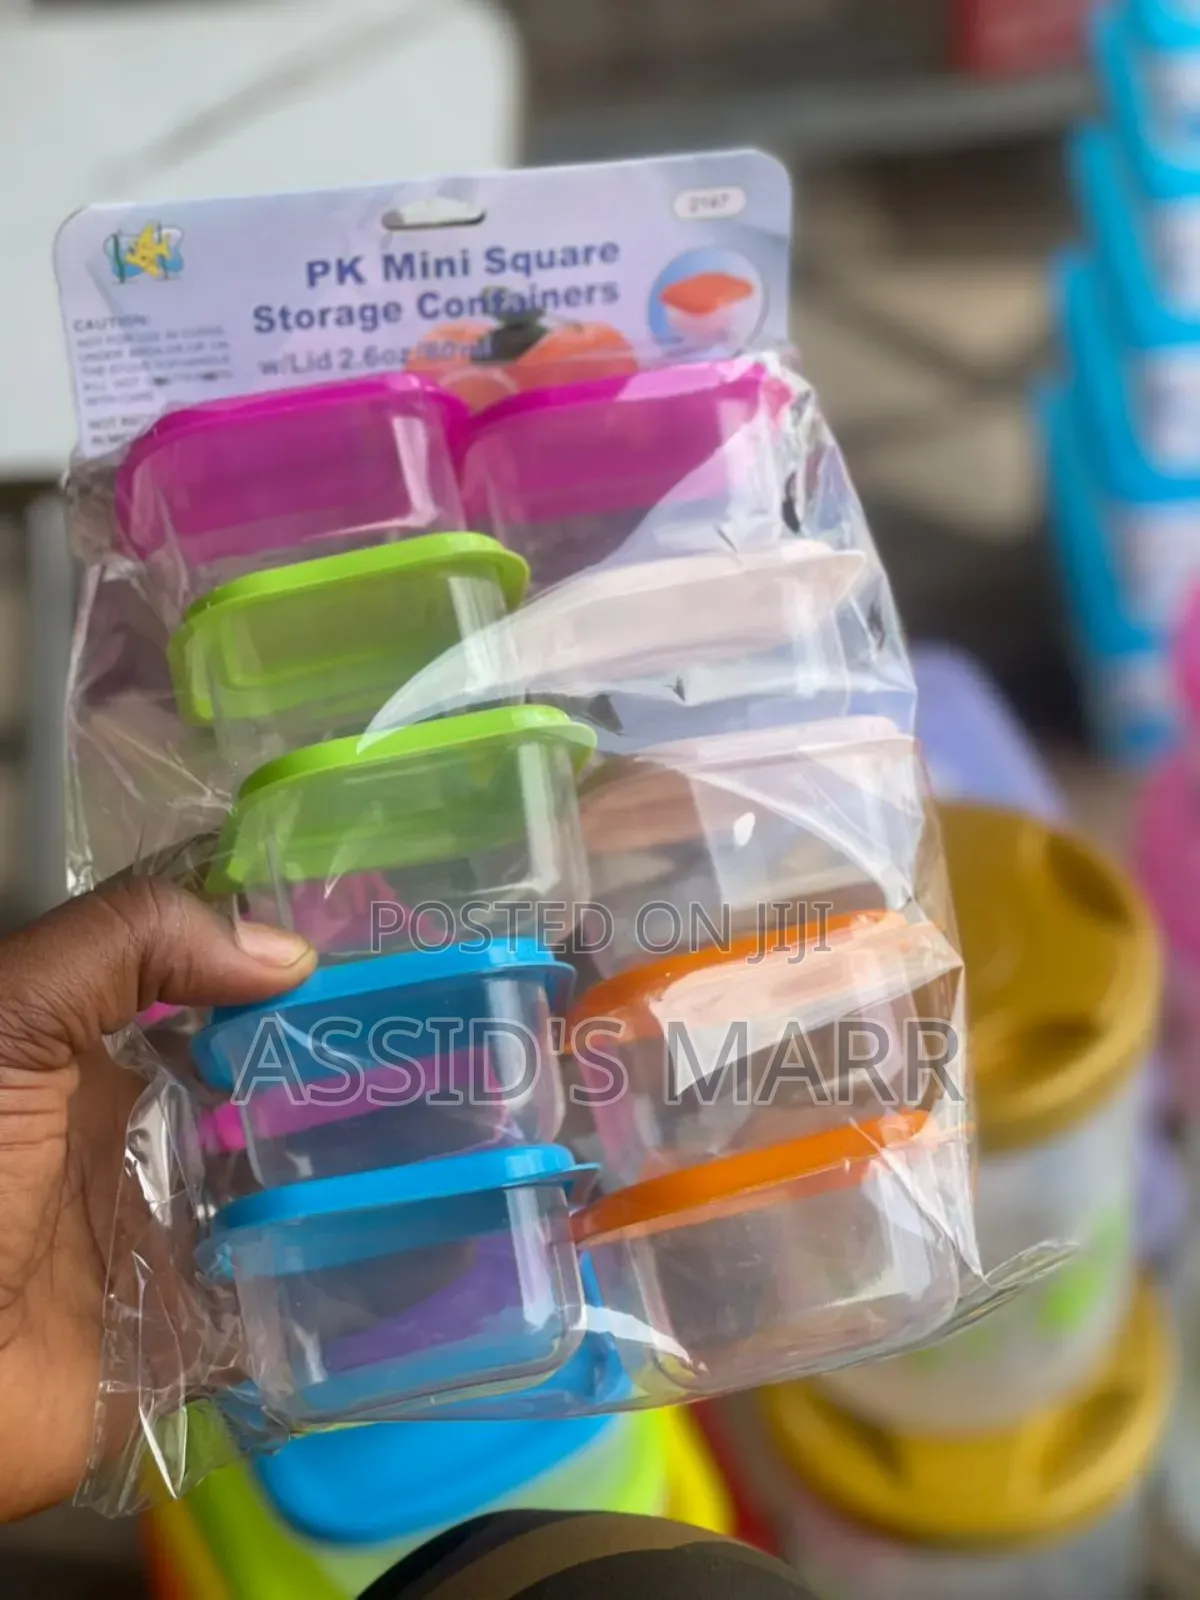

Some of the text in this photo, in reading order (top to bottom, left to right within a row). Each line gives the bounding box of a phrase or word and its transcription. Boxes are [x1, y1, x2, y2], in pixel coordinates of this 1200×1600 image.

[306, 241, 620, 288] PK Mini Square
[252, 280, 620, 334] Storage Containers
